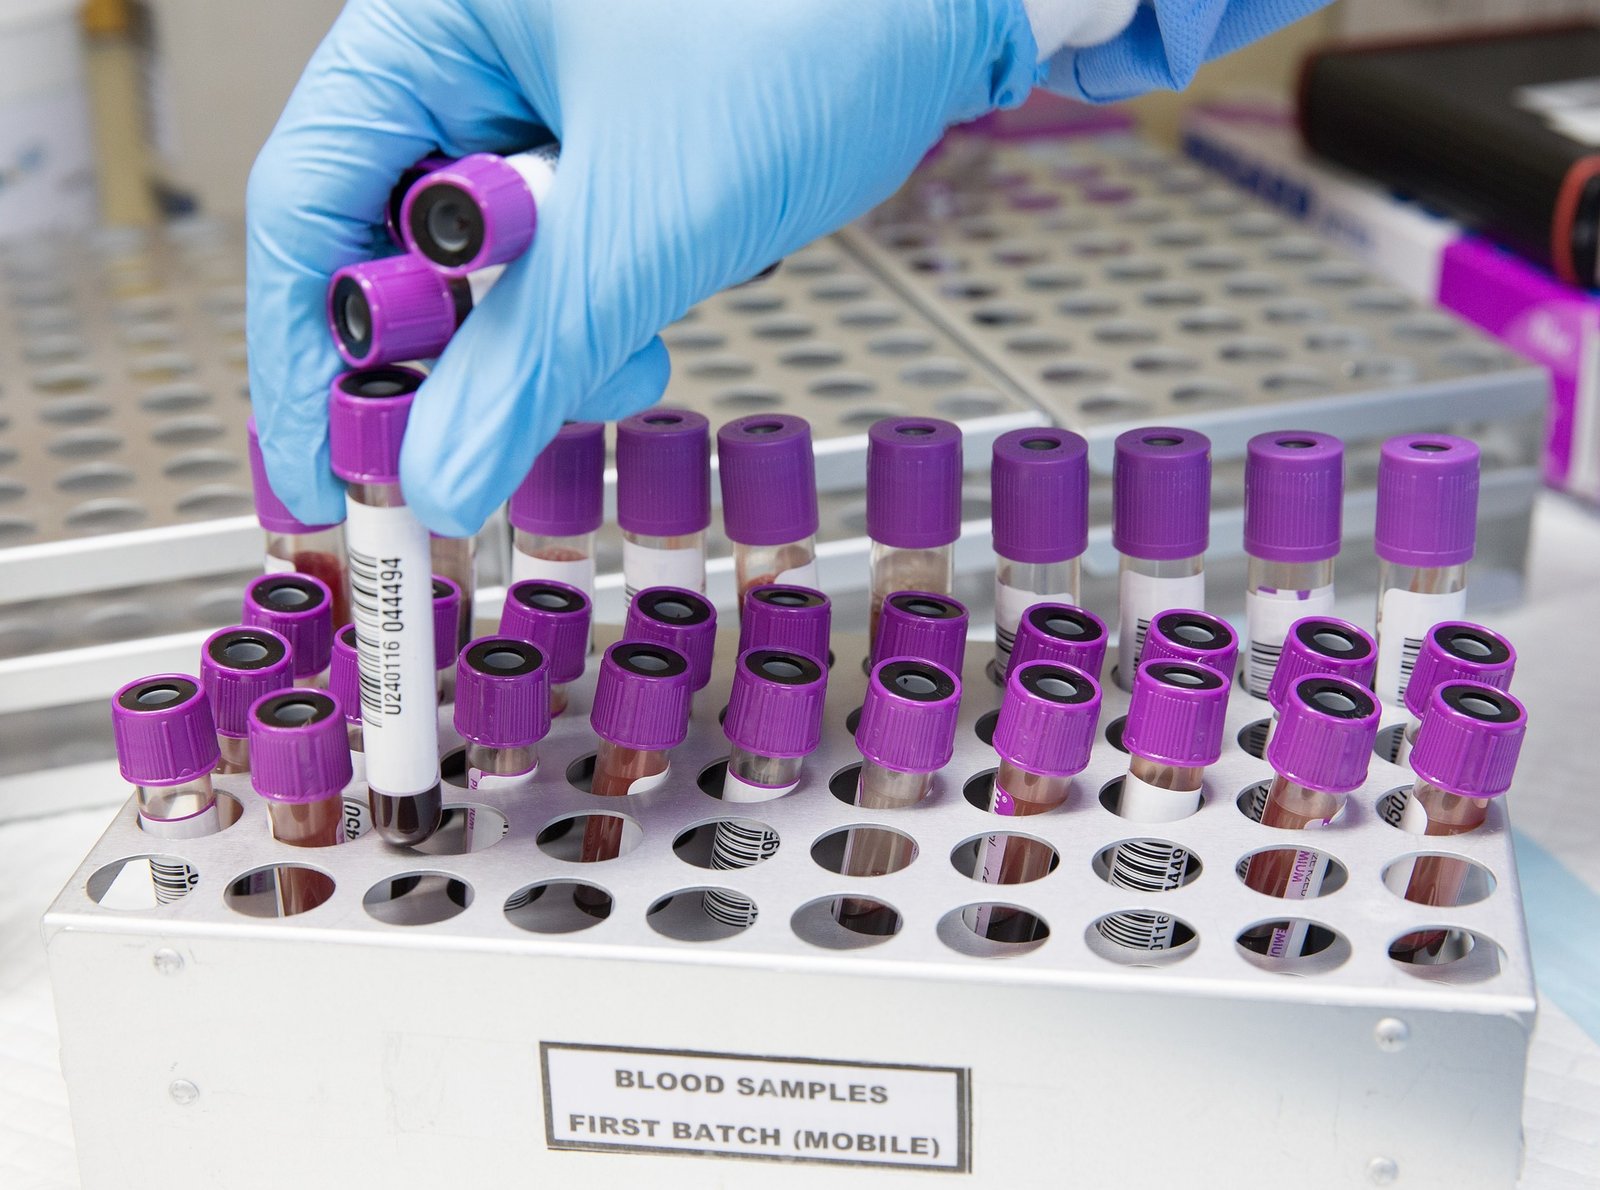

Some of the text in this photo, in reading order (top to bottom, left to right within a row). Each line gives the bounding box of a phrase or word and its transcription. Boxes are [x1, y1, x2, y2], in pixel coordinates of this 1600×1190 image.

[380, 557, 404, 715] U240116 044494
[614, 1069, 889, 1104] BLOOD SAMPLES
[568, 1113, 941, 1159] FIRST BATCH (MOBILE)
